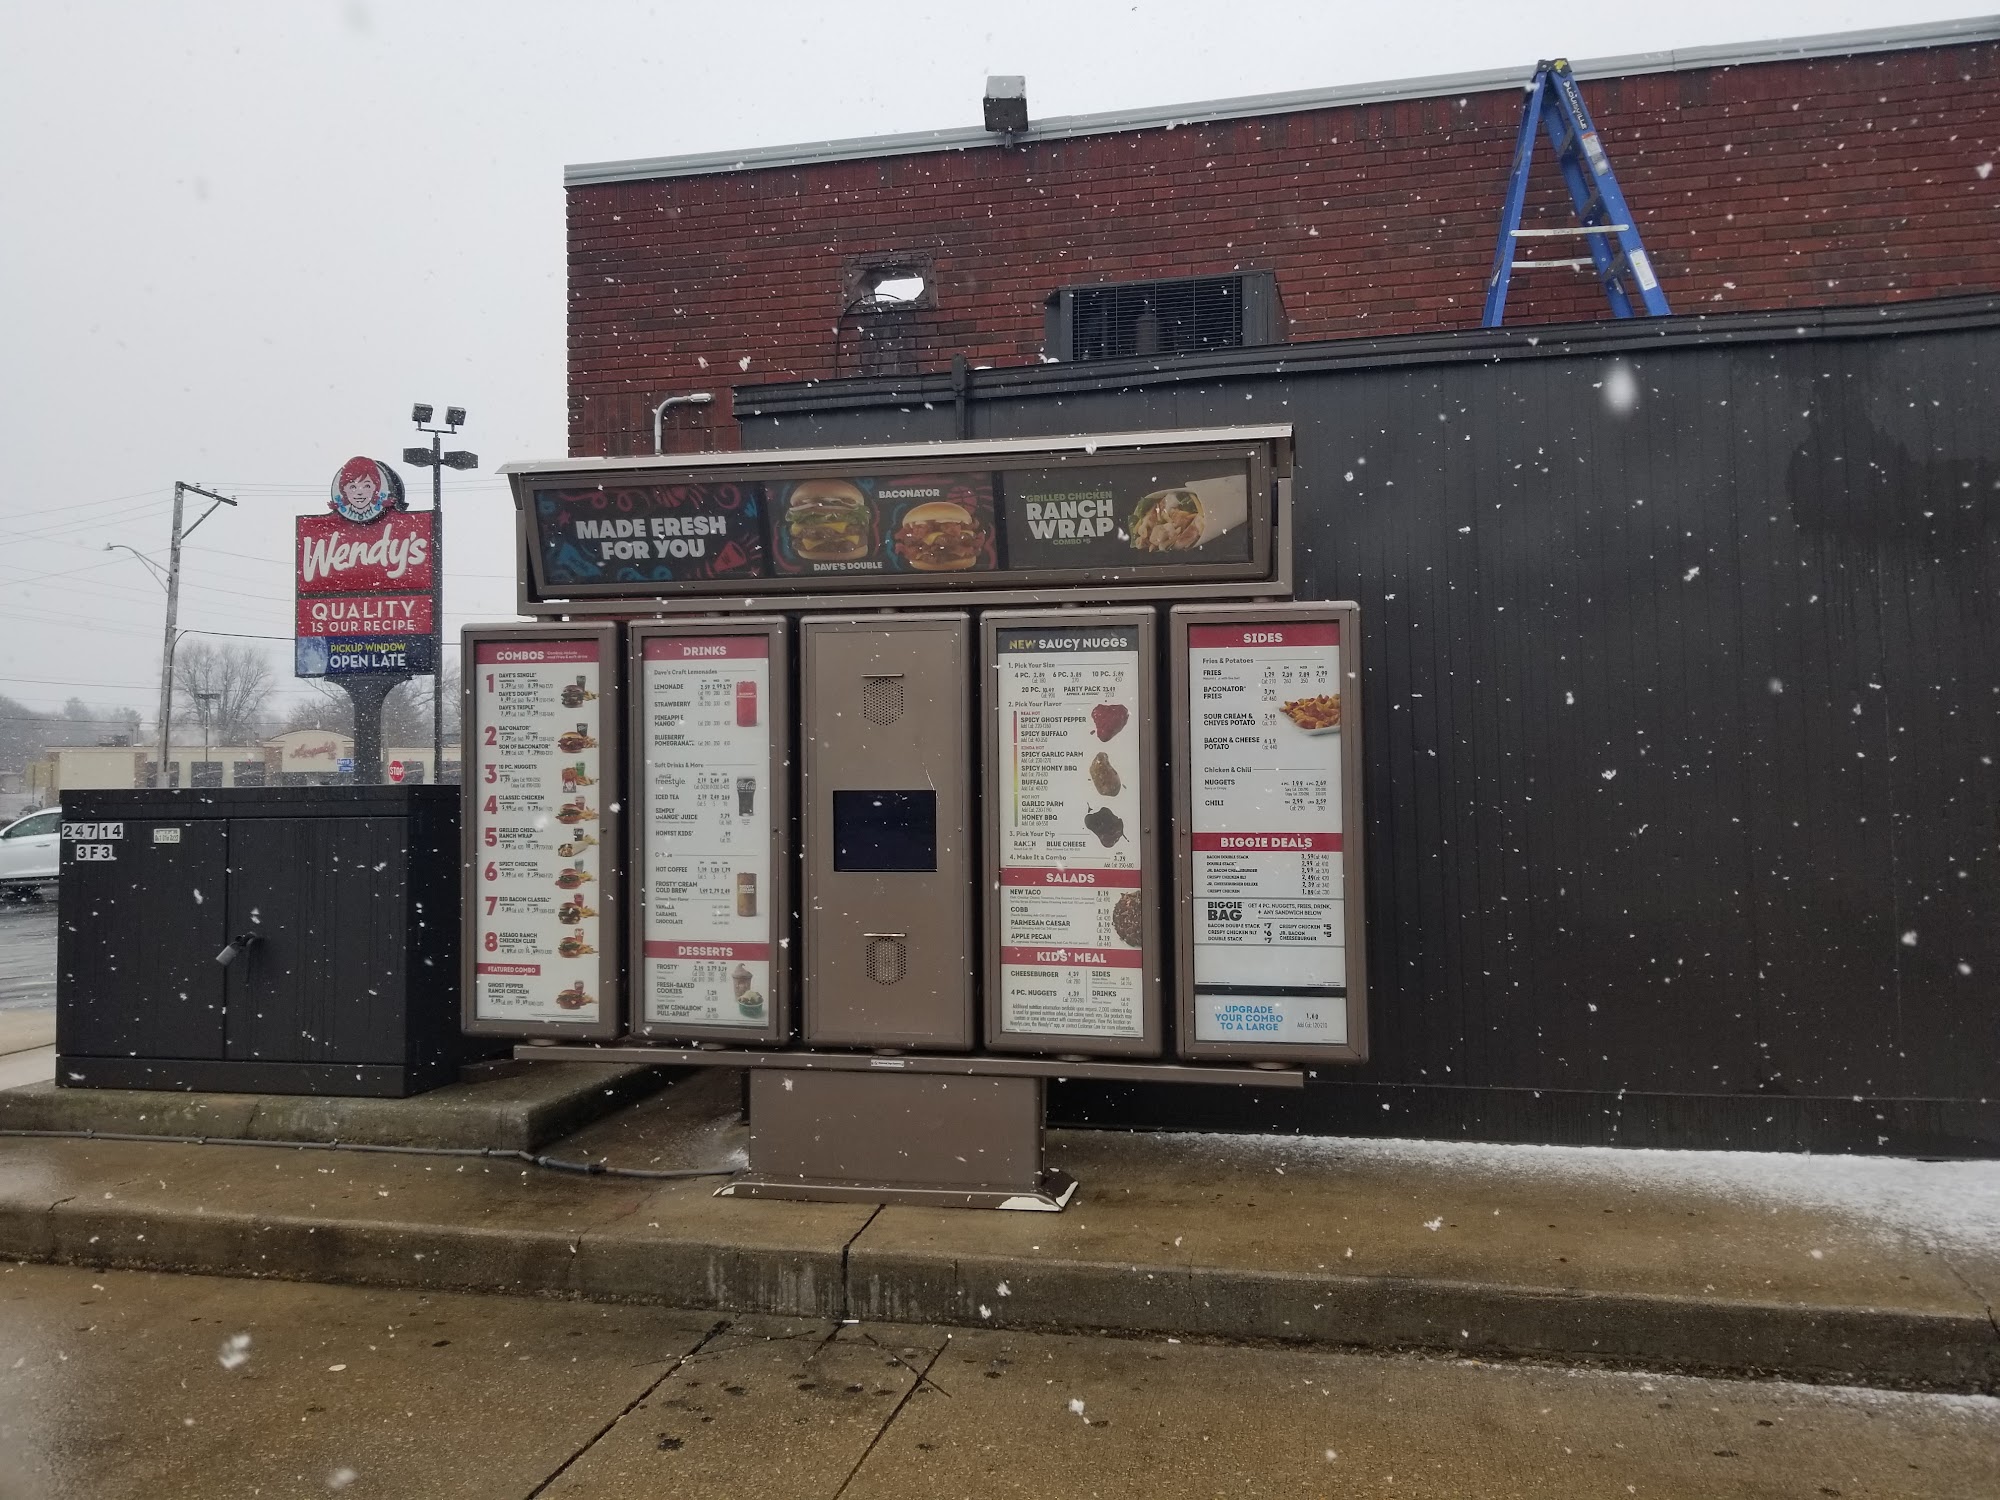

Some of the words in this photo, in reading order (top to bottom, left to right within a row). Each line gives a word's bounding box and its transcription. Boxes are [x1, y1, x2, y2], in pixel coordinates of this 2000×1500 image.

[1566, 87, 1588, 130] LOUISVILLE
[879, 489, 940, 498] BACONATOR
[1026, 493, 1066, 502] GRILLED
[1067, 491, 1112, 500] CHICKEN
[1026, 499, 1114, 520] RANCH
[575, 519, 647, 539] MADE
[651, 516, 727, 537] FRESH
[1028, 518, 1114, 539] WRAP
[303, 523, 427, 582] Wendy's
[601, 541, 650, 560] FOR
[653, 539, 705, 558] YOU
[814, 563, 846, 571] DAVE'S
[312, 601, 415, 620] QUALITY
[312, 622, 324, 633] IS
[329, 621, 358, 632] OUR
[364, 620, 415, 631] RECIPE
[1009, 640, 1034, 649] NEW
[1039, 638, 1080, 650] SAUCY
[1083, 637, 1127, 648] NUGGS
[1243, 633, 1283, 643] SIDES
[330, 644, 363, 653] PICKUP
[365, 642, 406, 651] WINDOW
[684, 646, 726, 656] DRINKS
[330, 655, 368, 667] OPEN
[373, 654, 406, 666] LATE
[496, 651, 544, 660] COMBOS
[486, 674, 494, 693] 1
[485, 726, 497, 745] 2
[390, 767, 403, 776] STOP
[485, 764, 497, 784] 3
[655, 778, 685, 787] freestyle
[484, 795, 498, 815] 4
[485, 828, 497, 847] 5
[1221, 838, 1268, 847] BIGGIE
[1271, 837, 1312, 848] DEALS
[78, 846, 110, 859] 3F3
[485, 862, 497, 881] 6
[1047, 873, 1095, 883] SALADS
[485, 896, 498, 915] 7
[1207, 910, 1242, 921] BAG
[485, 932, 498, 952] 8
[678, 946, 733, 956] DESSERTS
[1037, 951, 1071, 962] KIDS'
[1075, 953, 1106, 963] MEAL
[1215, 1014, 1242, 1022] YOUR
[1246, 1014, 1283, 1022] COMBO
[1220, 1022, 1233, 1030] TO
